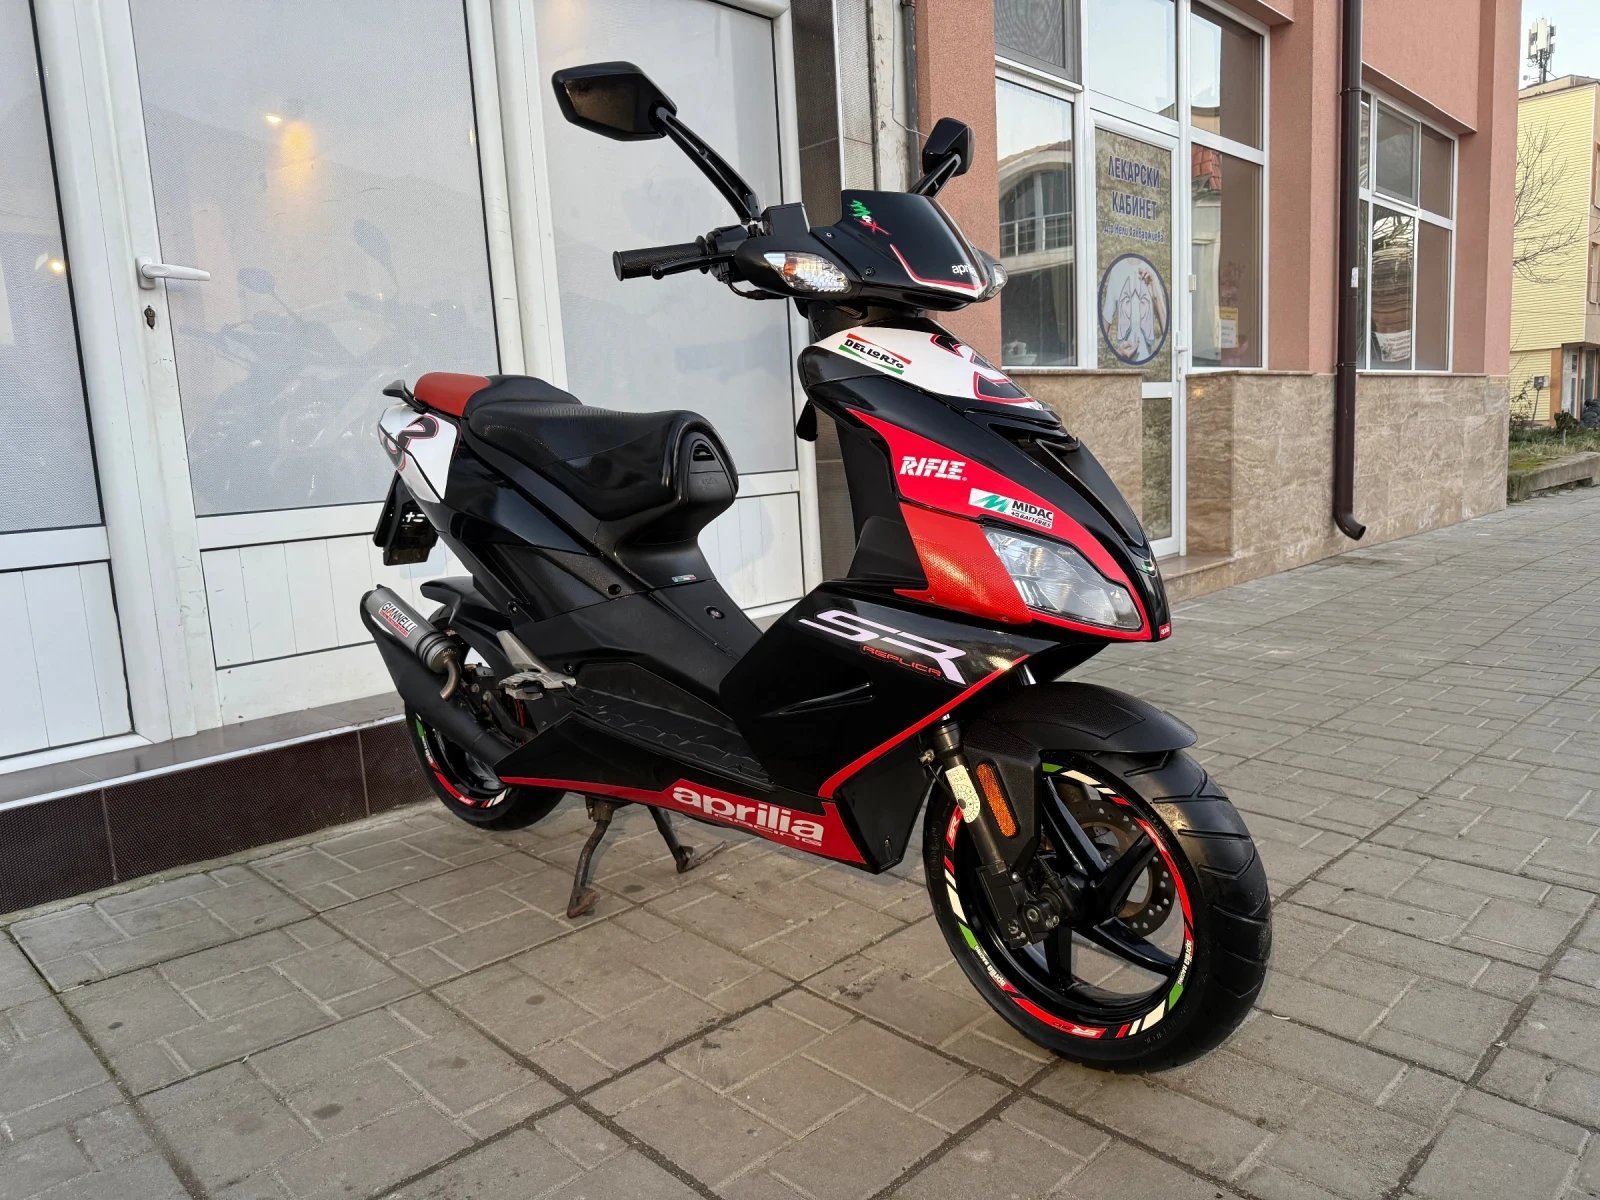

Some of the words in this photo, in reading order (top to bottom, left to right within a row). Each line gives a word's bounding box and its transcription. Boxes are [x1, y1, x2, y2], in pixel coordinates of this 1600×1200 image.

[1107, 155, 1160, 189] ЛЕКАРСКИ
[1111, 190, 1157, 221] КАБИНЕТ
[1115, 222, 1129, 236] Нели
[900, 456, 967, 481] RIFLE
[1011, 500, 1053, 521] MIDAC
[1019, 513, 1052, 528] BATTERIES
[381, 602, 416, 633] GIANNELLI
[798, 609, 967, 685] SR
[863, 645, 942, 678] REPLICA
[672, 786, 825, 842] aprilia
[974, 945, 990, 966] RACING
[987, 964, 1007, 987] aprilia
